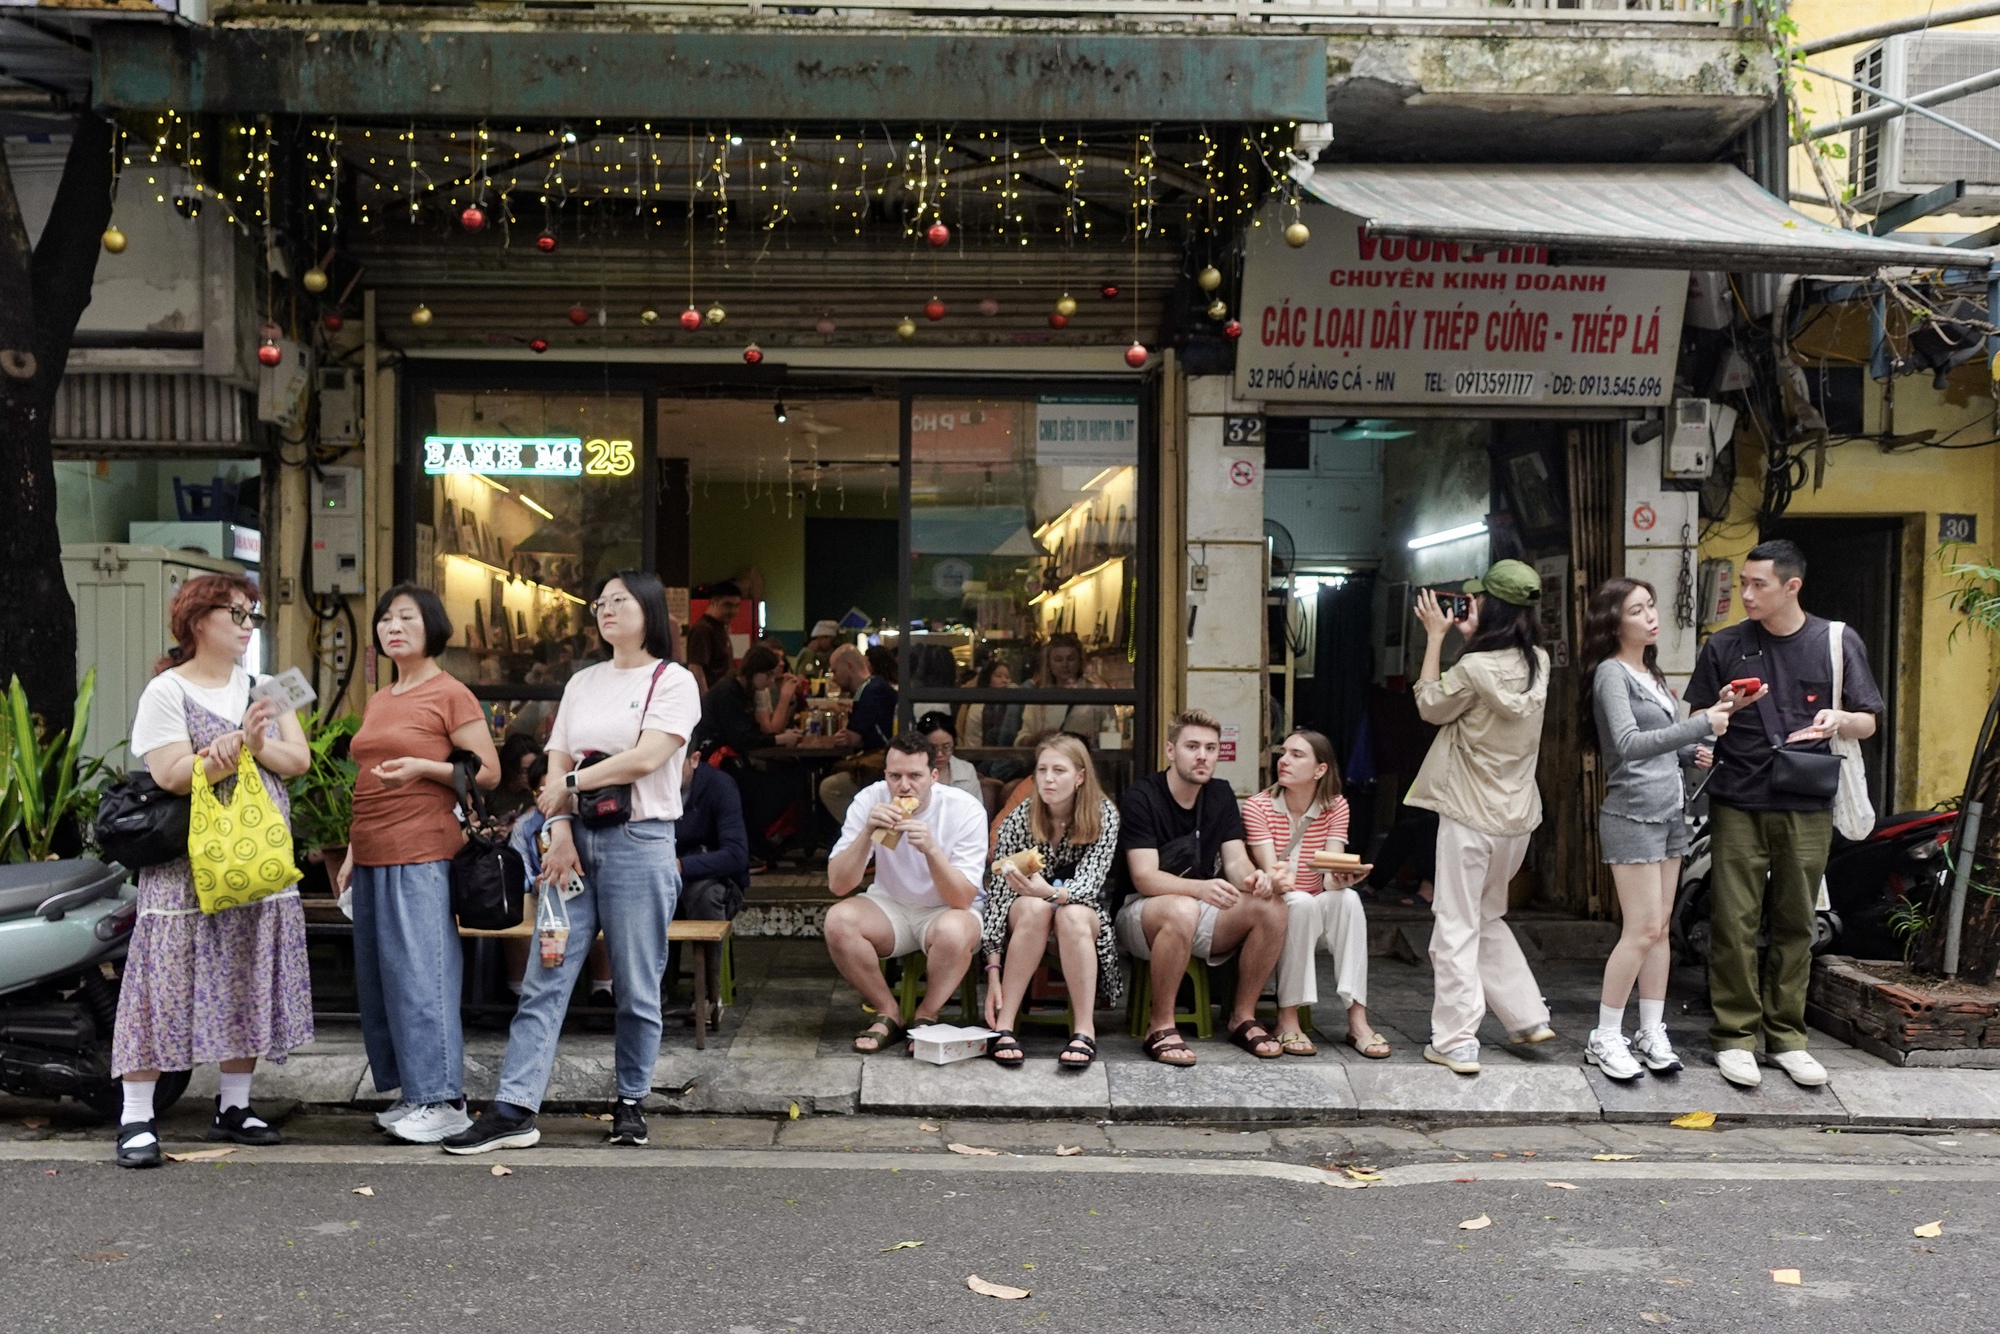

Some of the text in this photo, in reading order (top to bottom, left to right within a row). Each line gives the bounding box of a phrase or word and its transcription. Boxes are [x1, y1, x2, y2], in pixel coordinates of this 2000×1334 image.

[1329, 267, 1606, 292] CHUYÊN KINH DOANH
[1261, 297, 1307, 347] CÁC
[1313, 307, 1365, 358] LOẠI
[1370, 300, 1417, 350] DÂY
[1423, 301, 1479, 351] THÉP
[1485, 300, 1548, 352] CỨNG
[1571, 305, 1627, 353] THÉP
[1632, 305, 1660, 355] LÁ
[1248, 368, 1263, 388] 32
[1266, 361, 1295, 389] PHỐ
[1298, 364, 1338, 391] HÀNG
[1342, 365, 1362, 391] CÁ
[1375, 371, 1395, 391] HN
[1455, 372, 1533, 395] 0913591117
[1579, 375, 1662, 397] 0913.545.696
[1229, 418, 1261, 441] 32
[424, 439, 635, 476] BANH MI 25
[1946, 519, 1969, 538] 30
